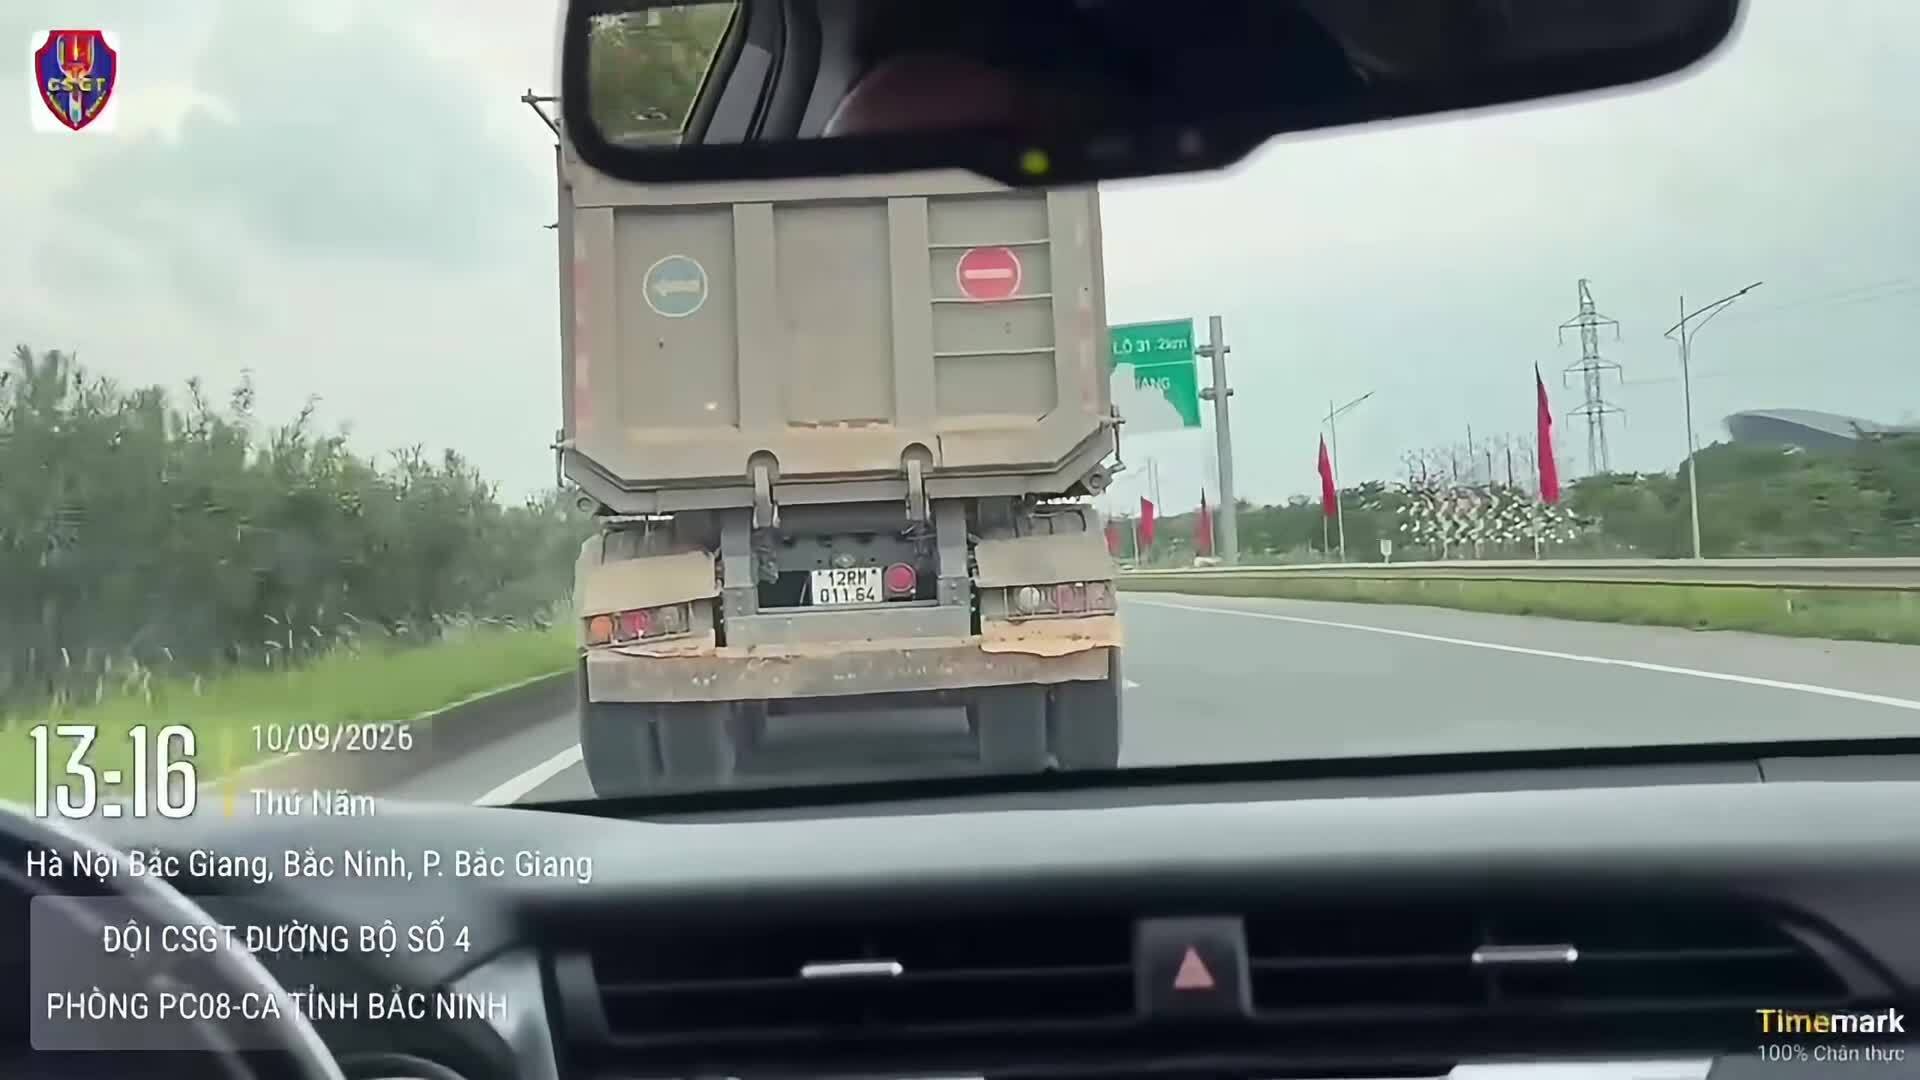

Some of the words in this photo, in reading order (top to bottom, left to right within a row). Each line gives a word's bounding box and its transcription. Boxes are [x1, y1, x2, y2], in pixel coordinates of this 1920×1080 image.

[1136, 339, 1151, 353] 31
[829, 570, 867, 586] 12RM
[820, 587, 875, 603] 011.64
